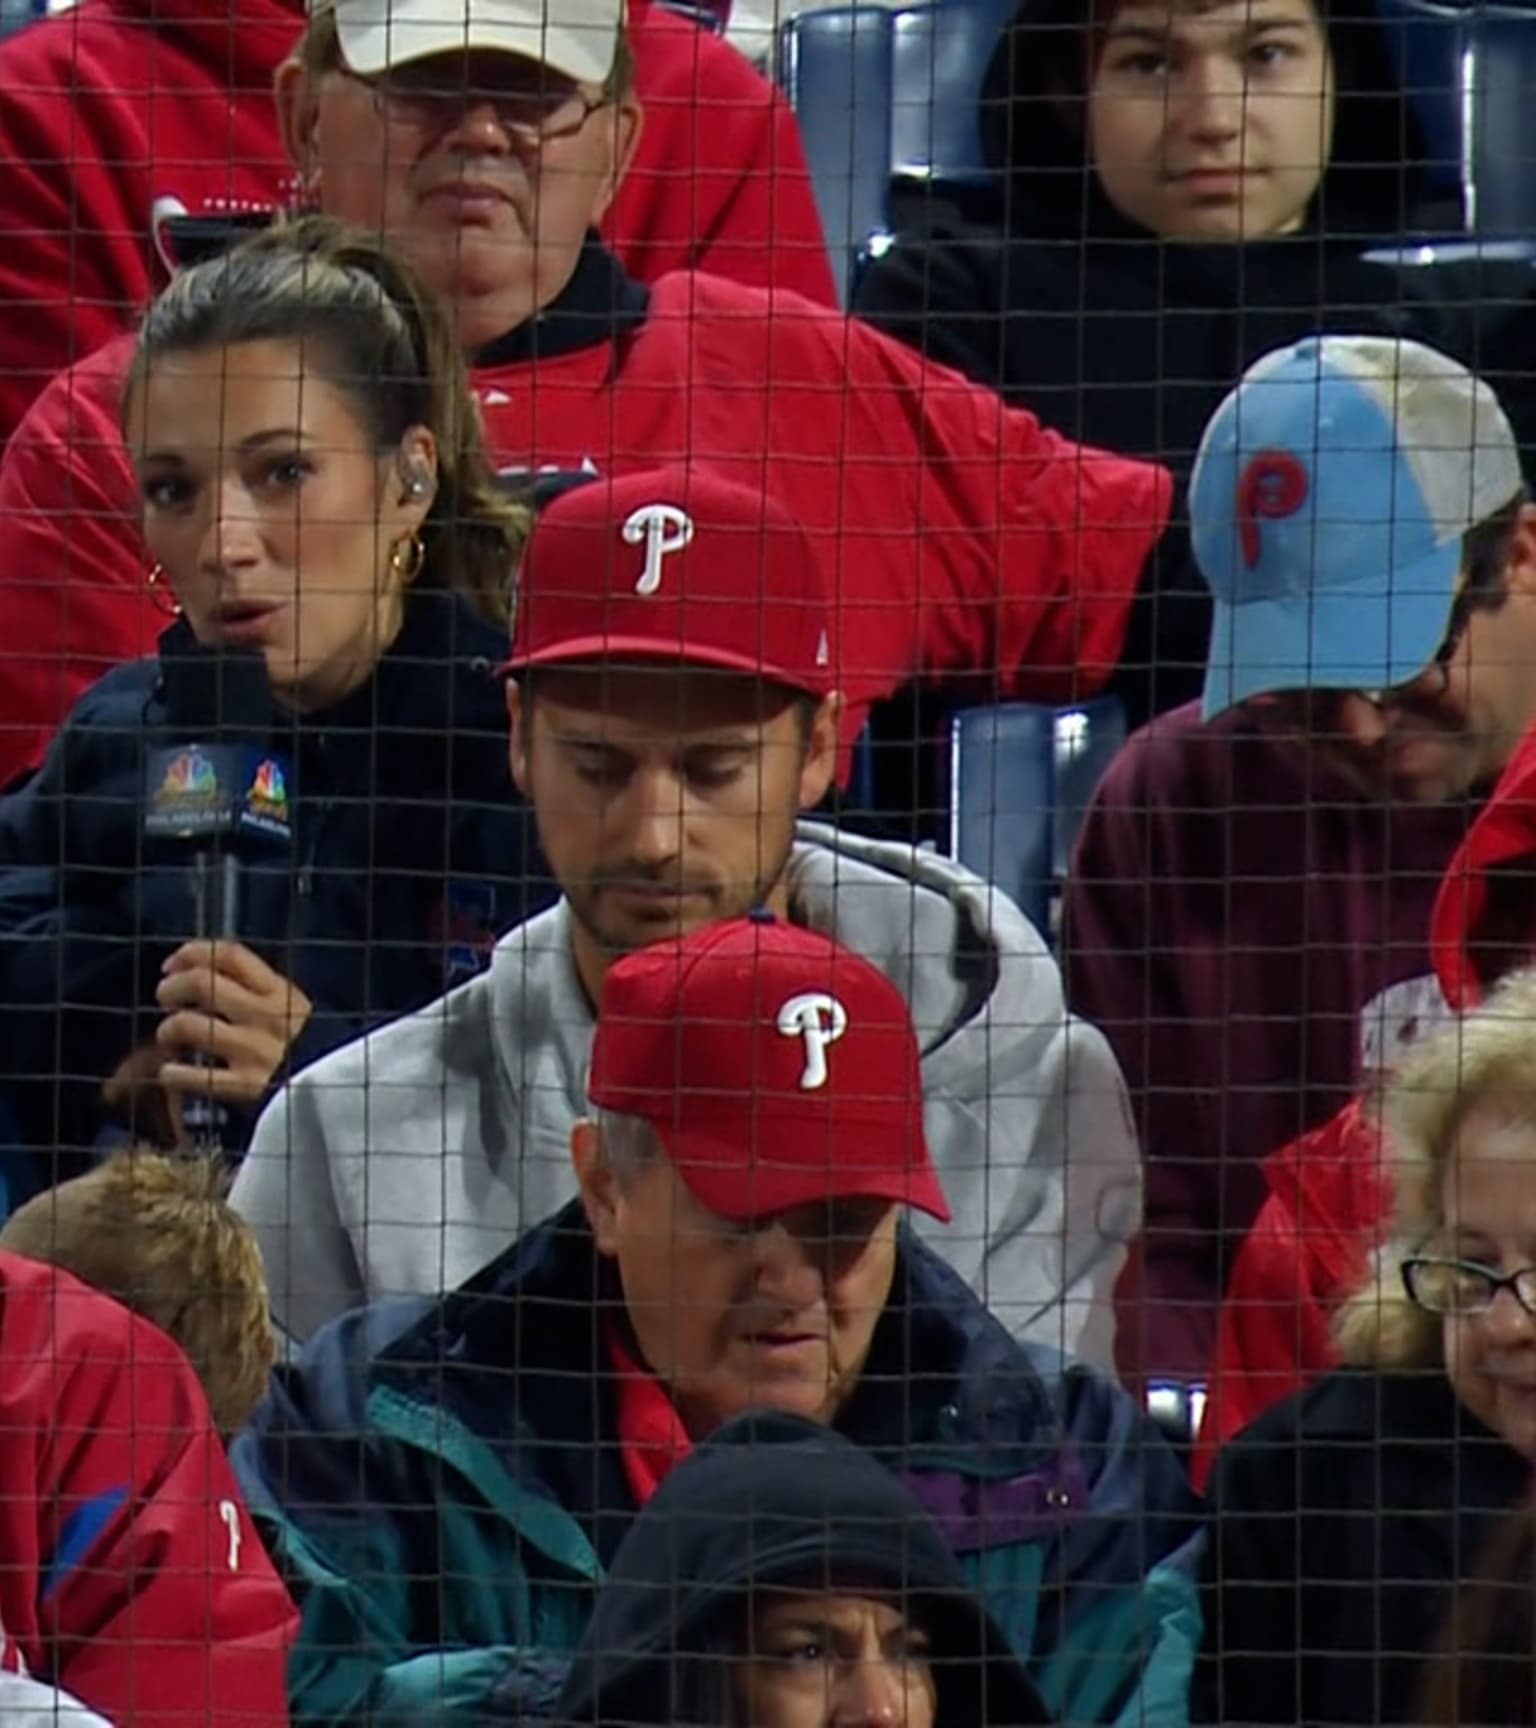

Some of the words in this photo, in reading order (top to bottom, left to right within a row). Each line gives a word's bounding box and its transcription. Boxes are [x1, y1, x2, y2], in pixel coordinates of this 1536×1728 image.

[622, 503, 694, 596] P
[1237, 448, 1308, 573] P
[777, 992, 848, 1089] P
